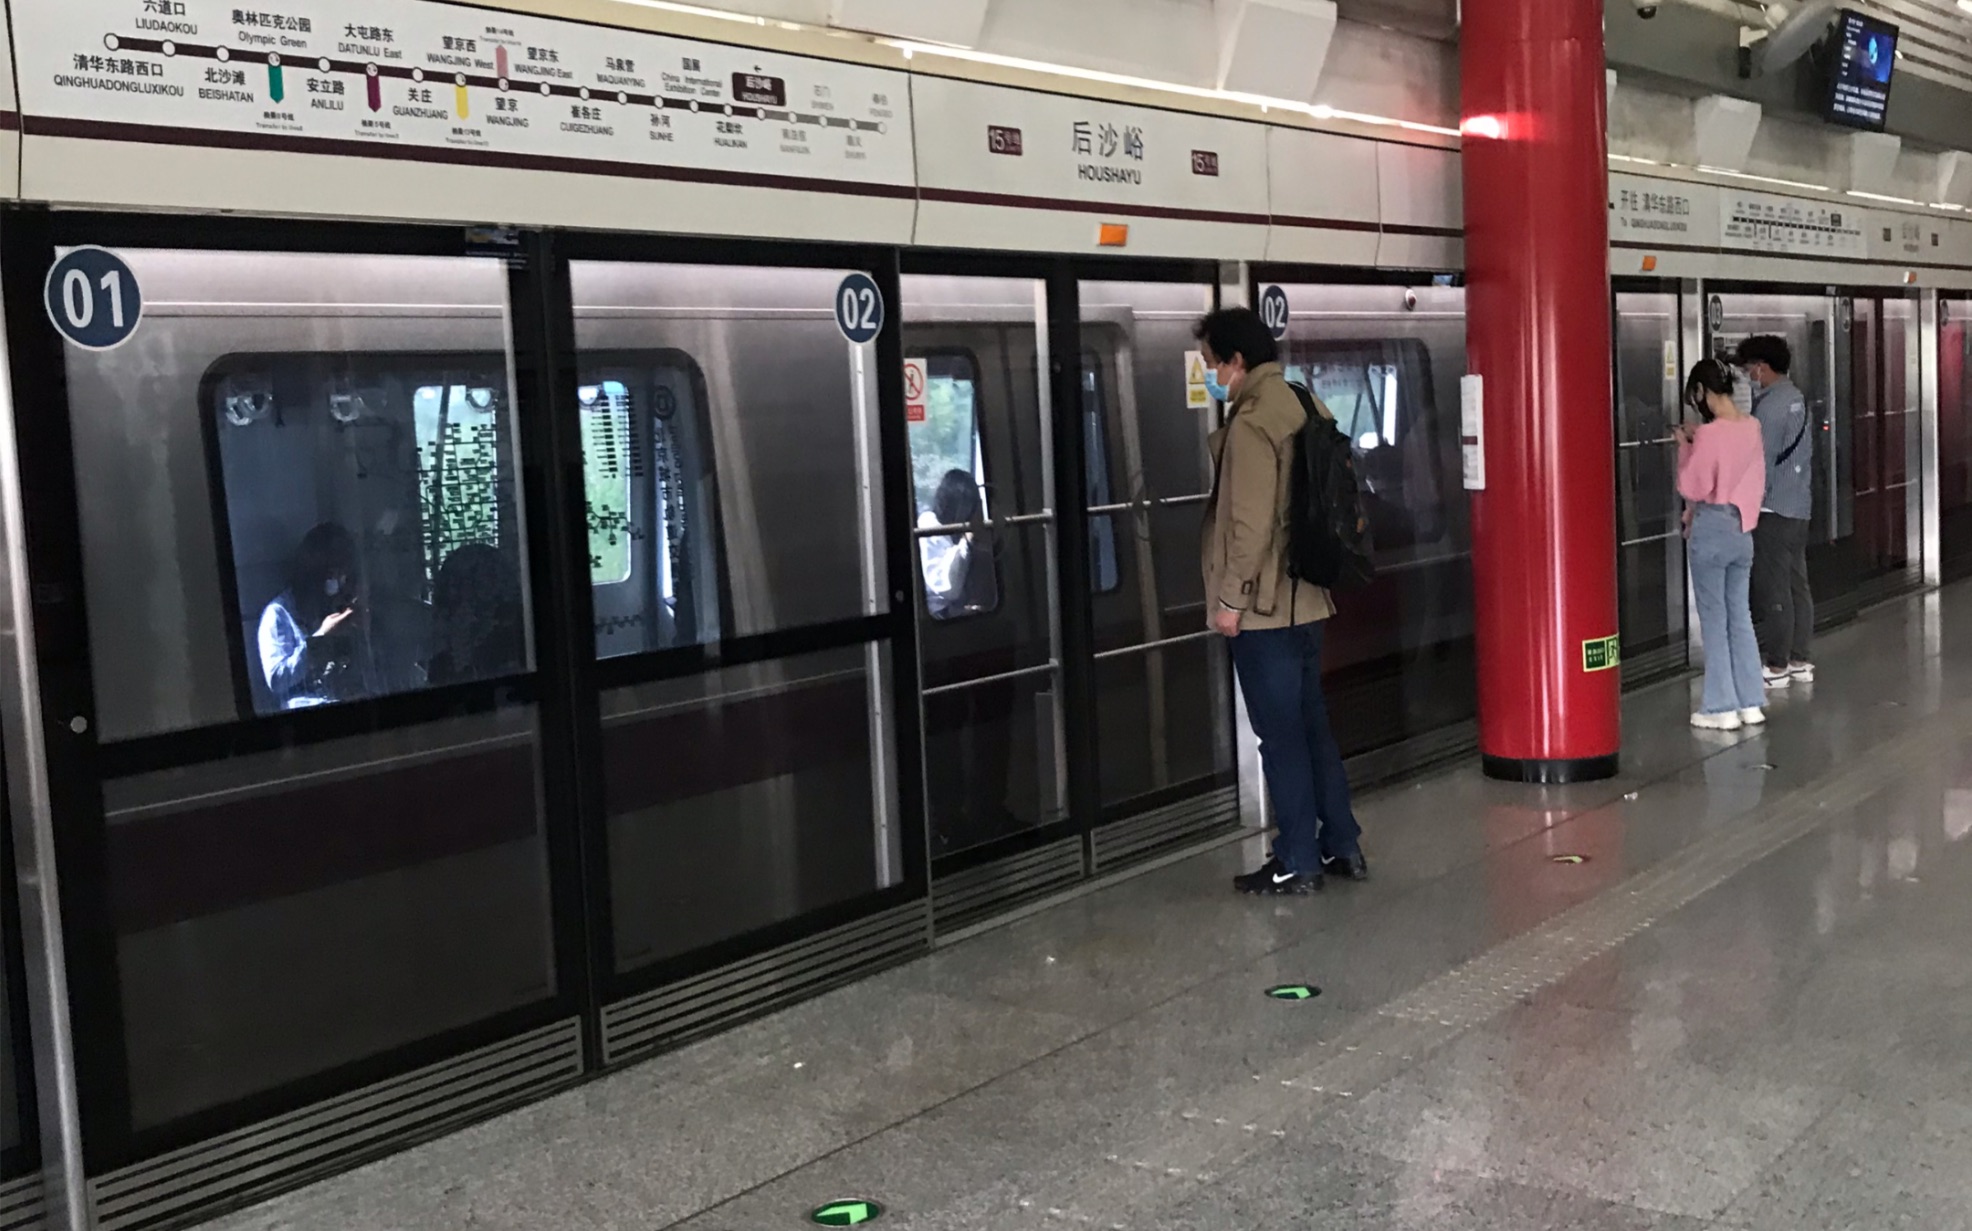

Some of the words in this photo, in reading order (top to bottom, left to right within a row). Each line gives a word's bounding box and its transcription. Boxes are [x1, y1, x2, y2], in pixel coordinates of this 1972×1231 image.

[143, 0, 186, 16] 六道口
[135, 18, 198, 35] LIUDAOKOU
[232, 9, 312, 33] 奥林匹克公园
[238, 31, 276, 46] Olympic
[280, 35, 307, 48] Green
[344, 23, 394, 43] 大屯路东
[338, 42, 380, 57] DATUNLU
[384, 48, 402, 59] East
[442, 35, 477, 53] 望京西
[427, 53, 471, 68] WANGJING
[474, 59, 494, 70] West
[527, 47, 559, 63] 望京东
[73, 53, 164, 77] 清华东路西口
[514, 63, 556, 77] WANGJING
[557, 68, 573, 79] East
[605, 57, 635, 72] 马泉营
[204, 67, 246, 86] 北沙滩
[597, 74, 645, 88] MAQUANYING
[53, 74, 184, 97] QINGHUADONGLUXIKOU
[306, 78, 345, 95] 安立路
[198, 88, 254, 103] BEISHATAN
[408, 88, 432, 103] 关庄
[311, 98, 344, 111] ANLILU
[393, 105, 449, 120] GUANZHUANG
[495, 97, 519, 112] 望京
[571, 104, 602, 121] 崔各庄
[486, 114, 529, 128] WANGJING
[650, 113, 671, 128] 孙河
[560, 122, 614, 137] CUIGEZHUANG
[649, 131, 674, 141] SUNHE
[1072, 121, 1144, 161] 后沙峪
[1079, 164, 1141, 185] HOUSHAYU
[63, 268, 124, 329] 01
[842, 287, 877, 330] 02
[1265, 296, 1286, 329] 02
